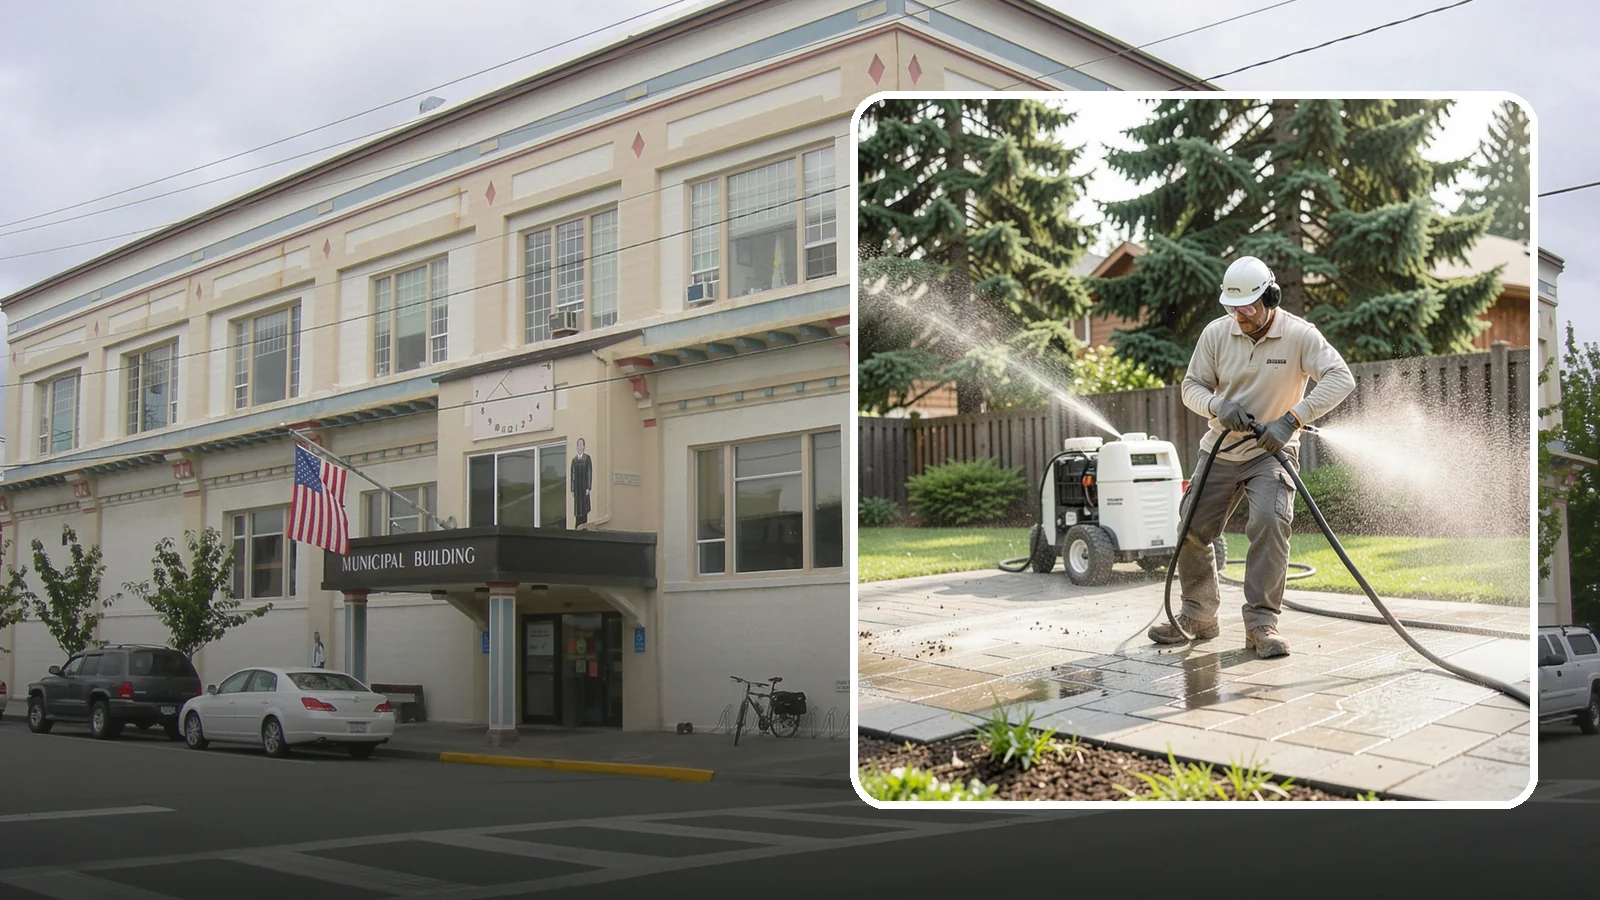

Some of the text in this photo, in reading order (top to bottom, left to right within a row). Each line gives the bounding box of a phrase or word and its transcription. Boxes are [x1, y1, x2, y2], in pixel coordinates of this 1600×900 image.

[536, 402, 540, 410] 4
[480, 407, 485, 415] 8
[488, 417, 492, 426] 9
[529, 414, 533, 422] 3
[494, 423, 500, 432] 10
[521, 420, 526, 428] 2
[507, 425, 513, 433] 12
[342, 546, 475, 572] MUNICIPAL BUILDING
